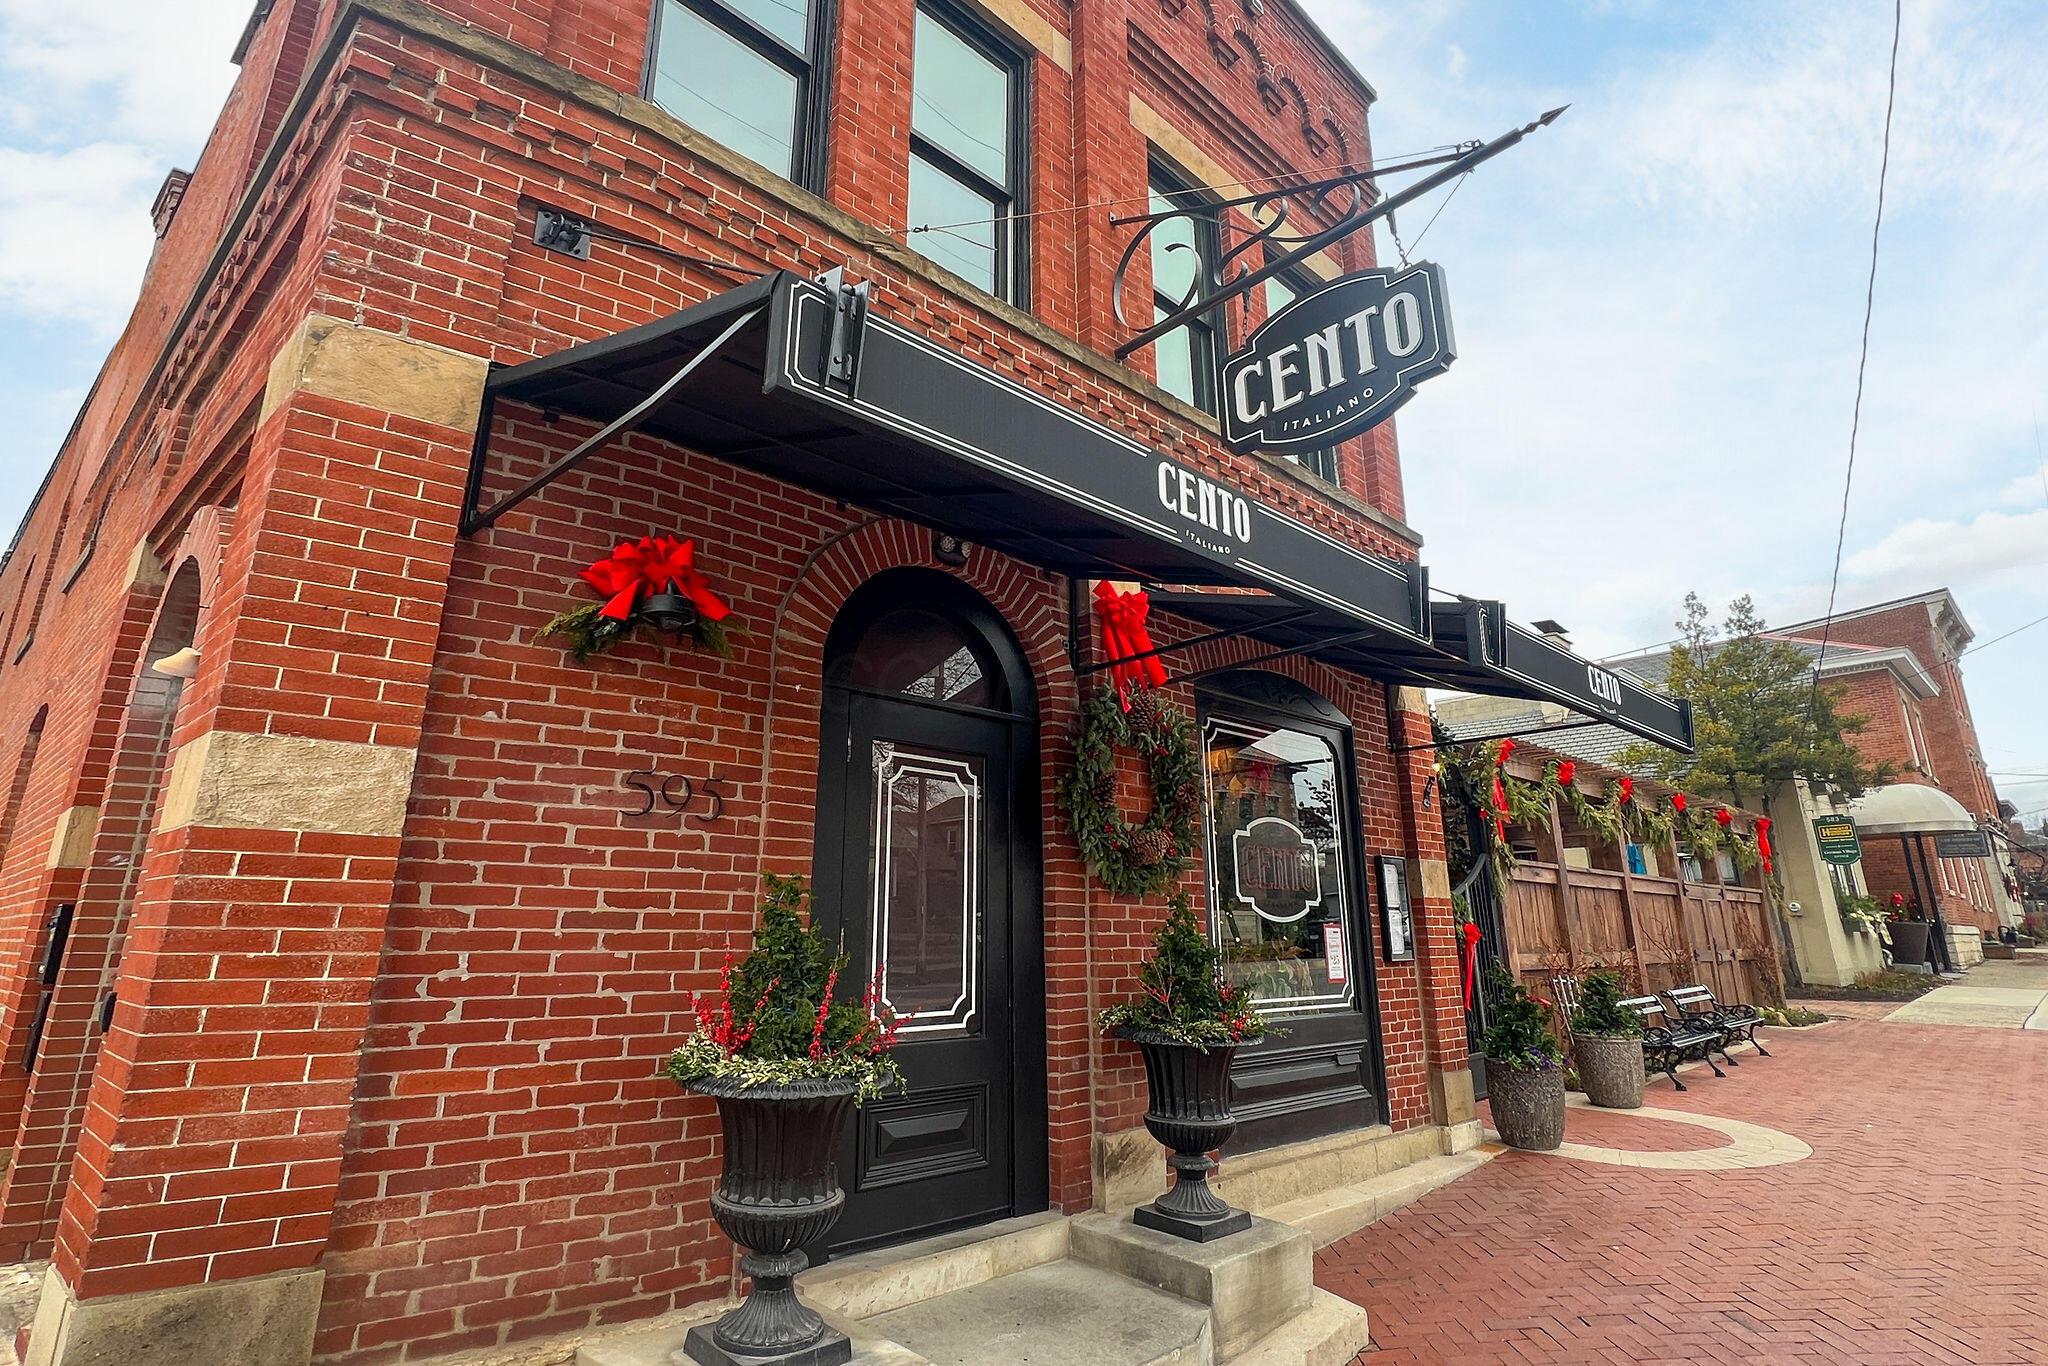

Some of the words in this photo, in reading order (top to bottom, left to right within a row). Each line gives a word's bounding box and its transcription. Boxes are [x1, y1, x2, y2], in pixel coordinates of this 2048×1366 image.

[1234, 292, 1424, 424] CENTO
[1283, 387, 1375, 432] ITALIANO
[1158, 461, 1251, 544] CENTO
[1185, 529, 1231, 554] ITALIANO
[1587, 664, 1622, 706] CENTO
[619, 763, 725, 822] 595
[1242, 842, 1314, 892] CENTO
